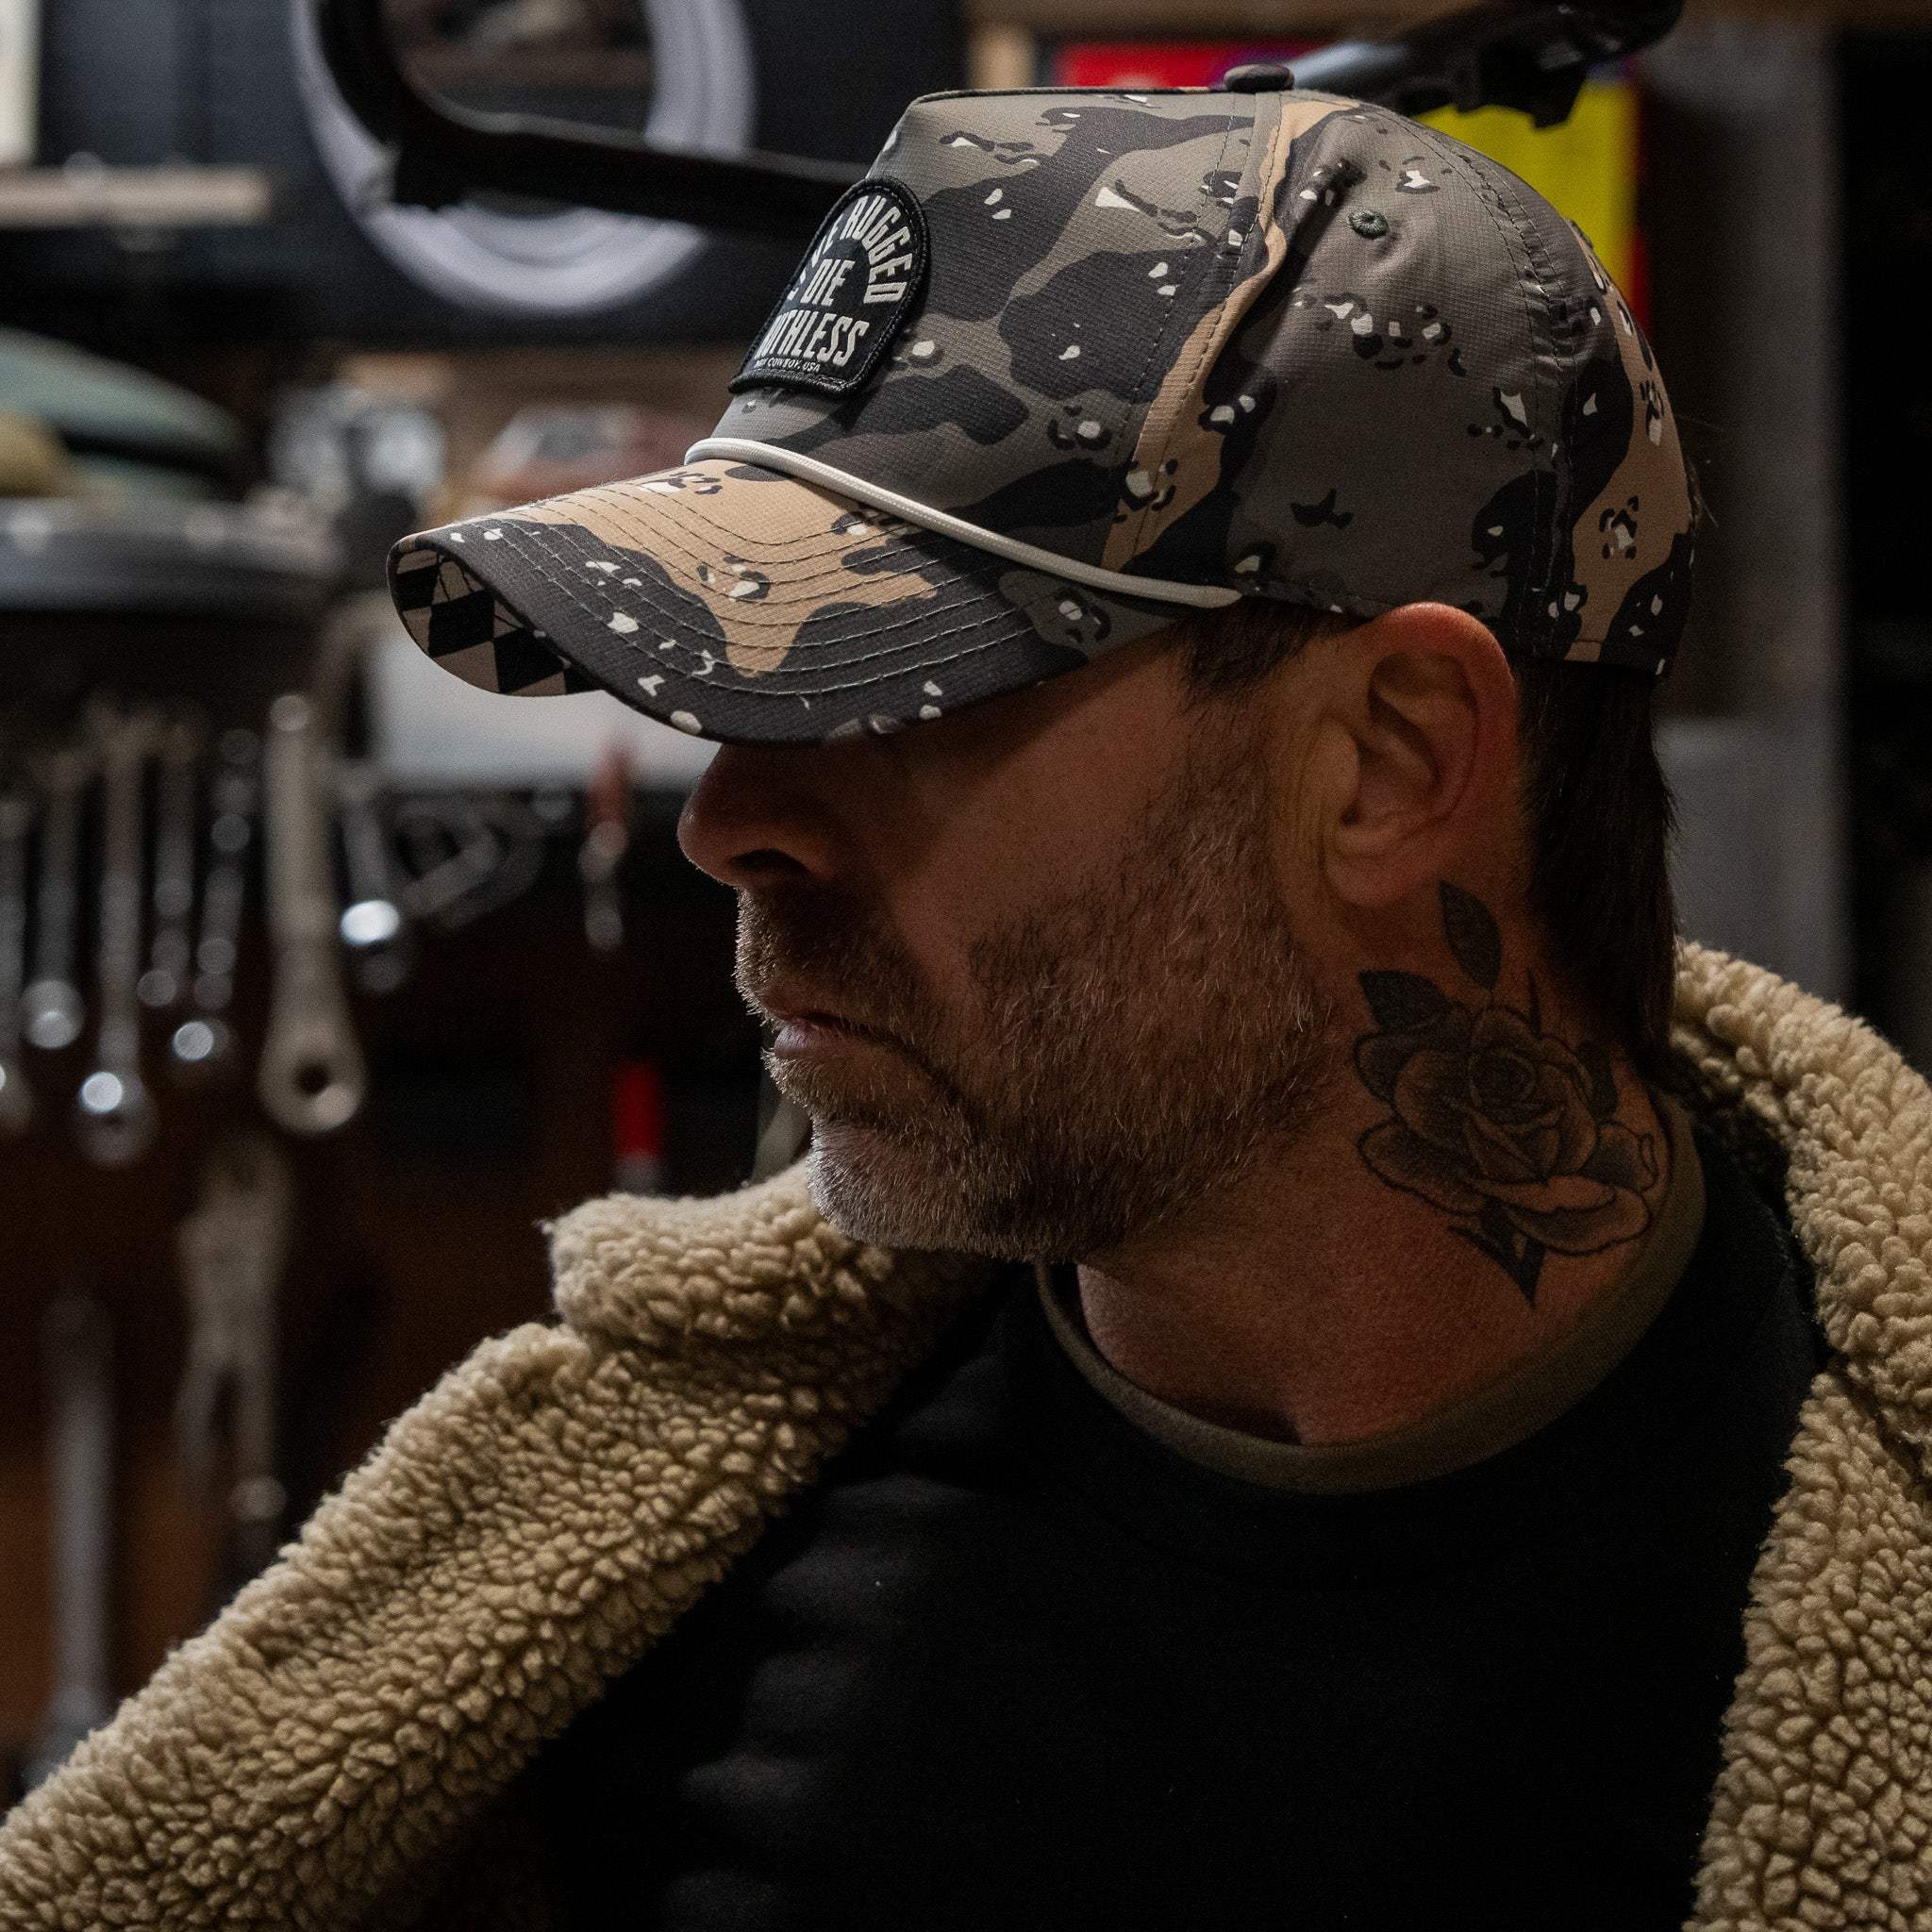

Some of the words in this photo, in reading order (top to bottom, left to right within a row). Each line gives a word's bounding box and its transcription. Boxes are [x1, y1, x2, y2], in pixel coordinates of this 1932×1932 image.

[840, 194, 913, 305] RUGGED
[800, 258, 856, 307] DIE
[802, 361, 821, 373] USA
